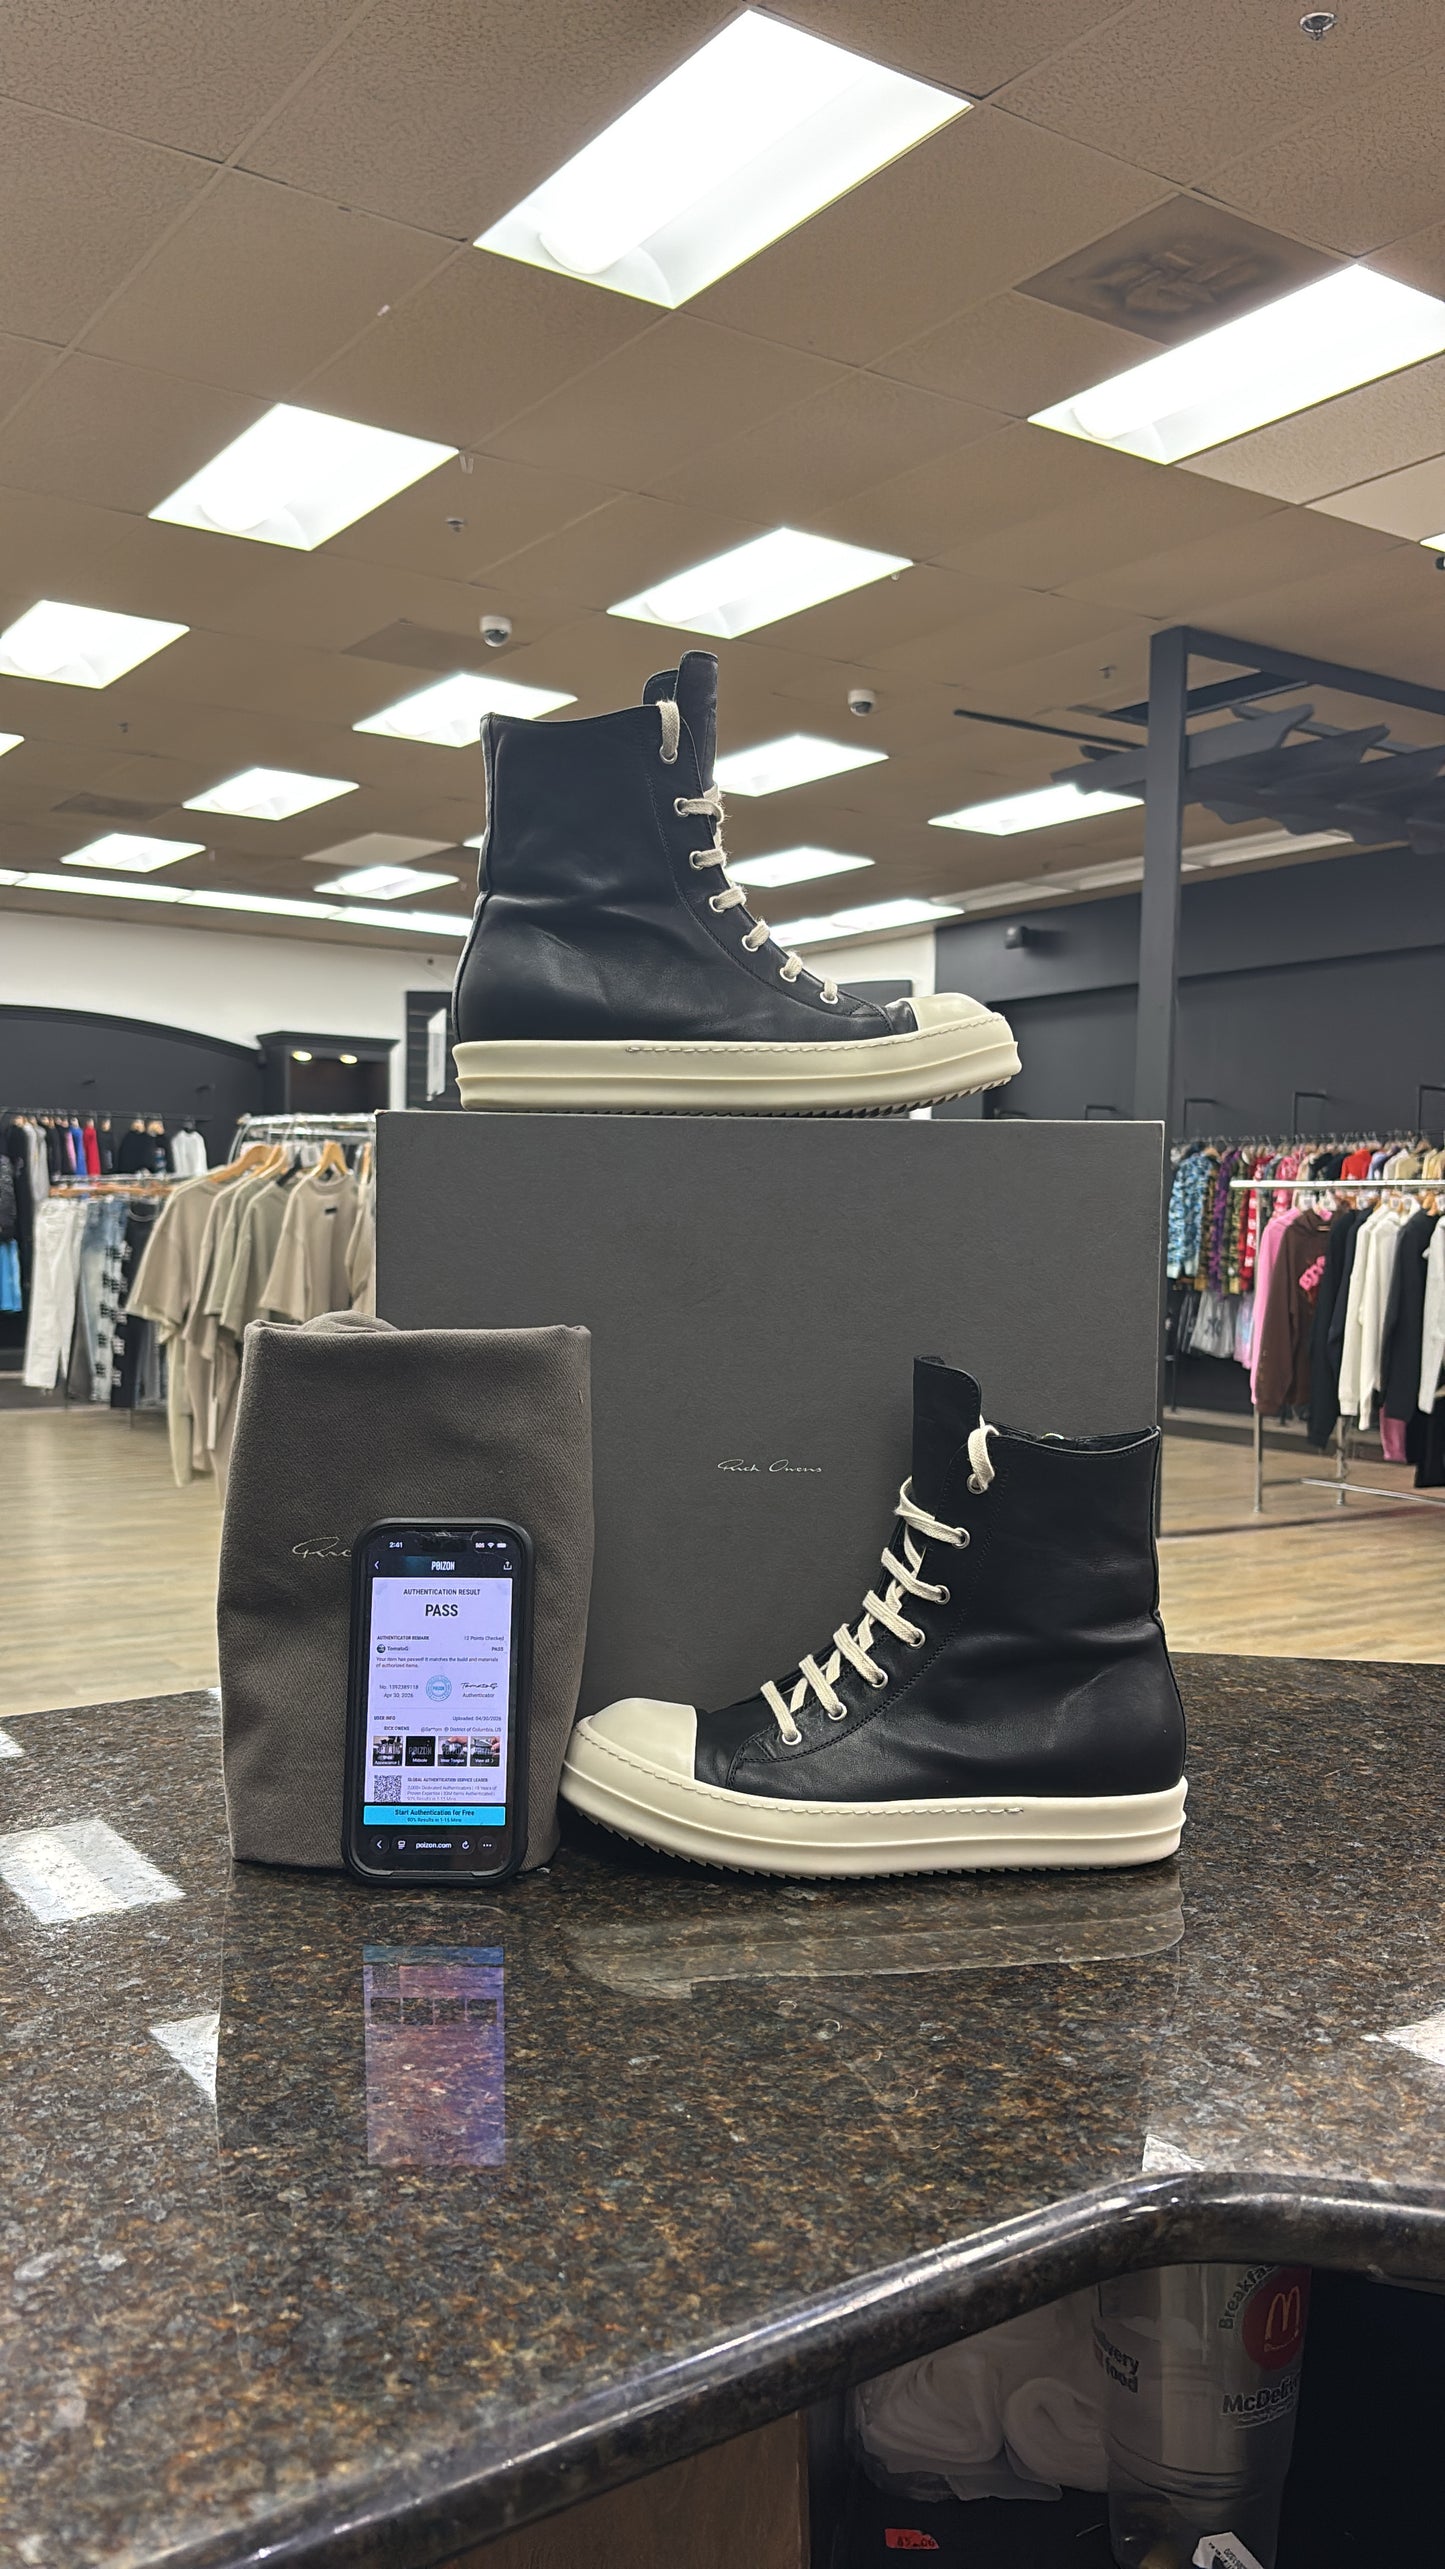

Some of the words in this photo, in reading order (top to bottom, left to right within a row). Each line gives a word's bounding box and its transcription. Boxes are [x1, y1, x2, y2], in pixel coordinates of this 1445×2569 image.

[717, 1458, 760, 1472] Rick
[768, 1458, 822, 1472] Owens
[292, 1536, 352, 1558] Ric
[431, 1561, 455, 1571] POIZON
[425, 1604, 458, 1617] PASS
[1218, 2265, 1275, 2330] Breakfa
